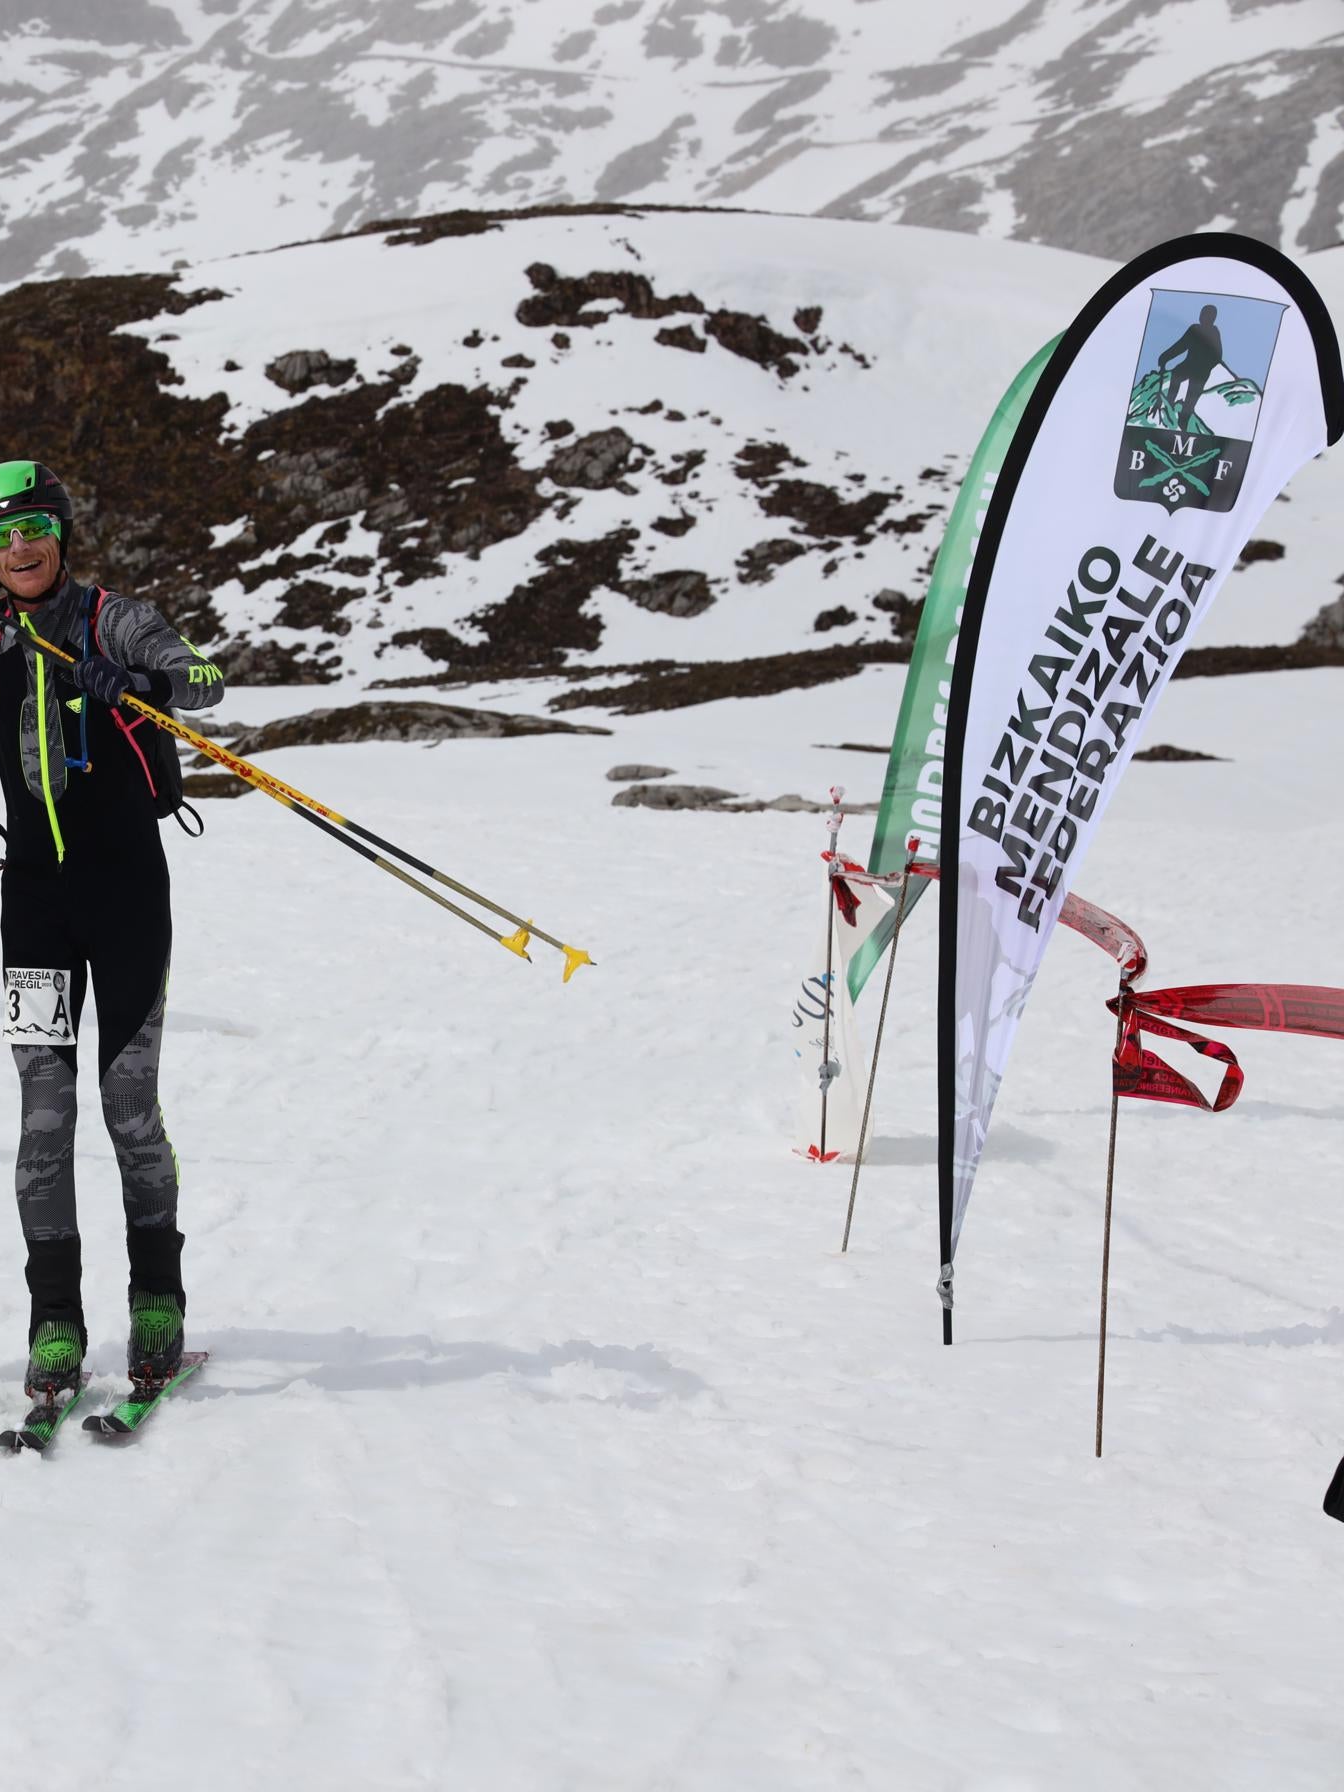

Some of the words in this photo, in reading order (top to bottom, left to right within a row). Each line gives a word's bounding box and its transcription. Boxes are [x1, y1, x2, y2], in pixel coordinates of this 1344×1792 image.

[1130, 450, 1146, 470] B
[1172, 435, 1194, 457] M
[1215, 460, 1234, 480] F
[967, 545, 1121, 843] BIZKAIKO
[995, 534, 1184, 900] MENDIZALE
[1018, 560, 1217, 934] FEDERAZIOA
[9, 989, 21, 1022] 3
[51, 994, 69, 1025] A
[14, 980, 42, 989] REGIL
